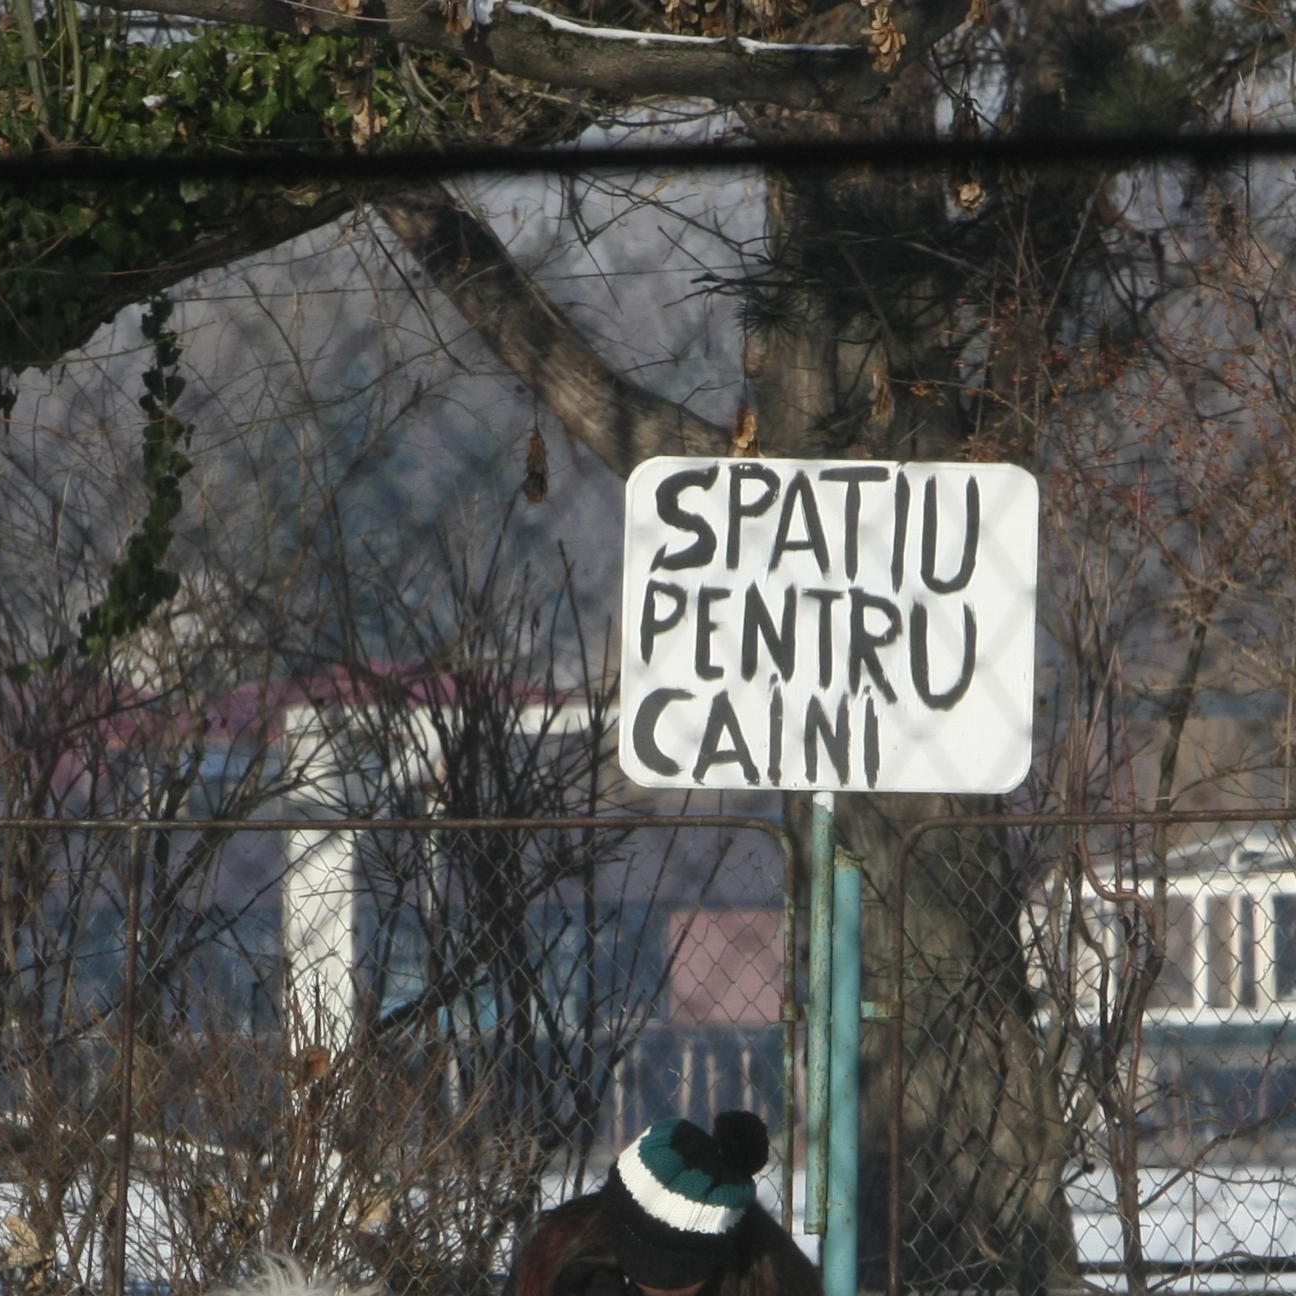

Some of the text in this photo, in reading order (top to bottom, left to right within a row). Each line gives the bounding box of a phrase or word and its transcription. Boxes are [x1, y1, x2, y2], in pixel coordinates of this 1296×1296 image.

[650, 461, 981, 594] SPATIU
[640, 579, 978, 711] PENTRU
[632, 678, 880, 790] CAINI
